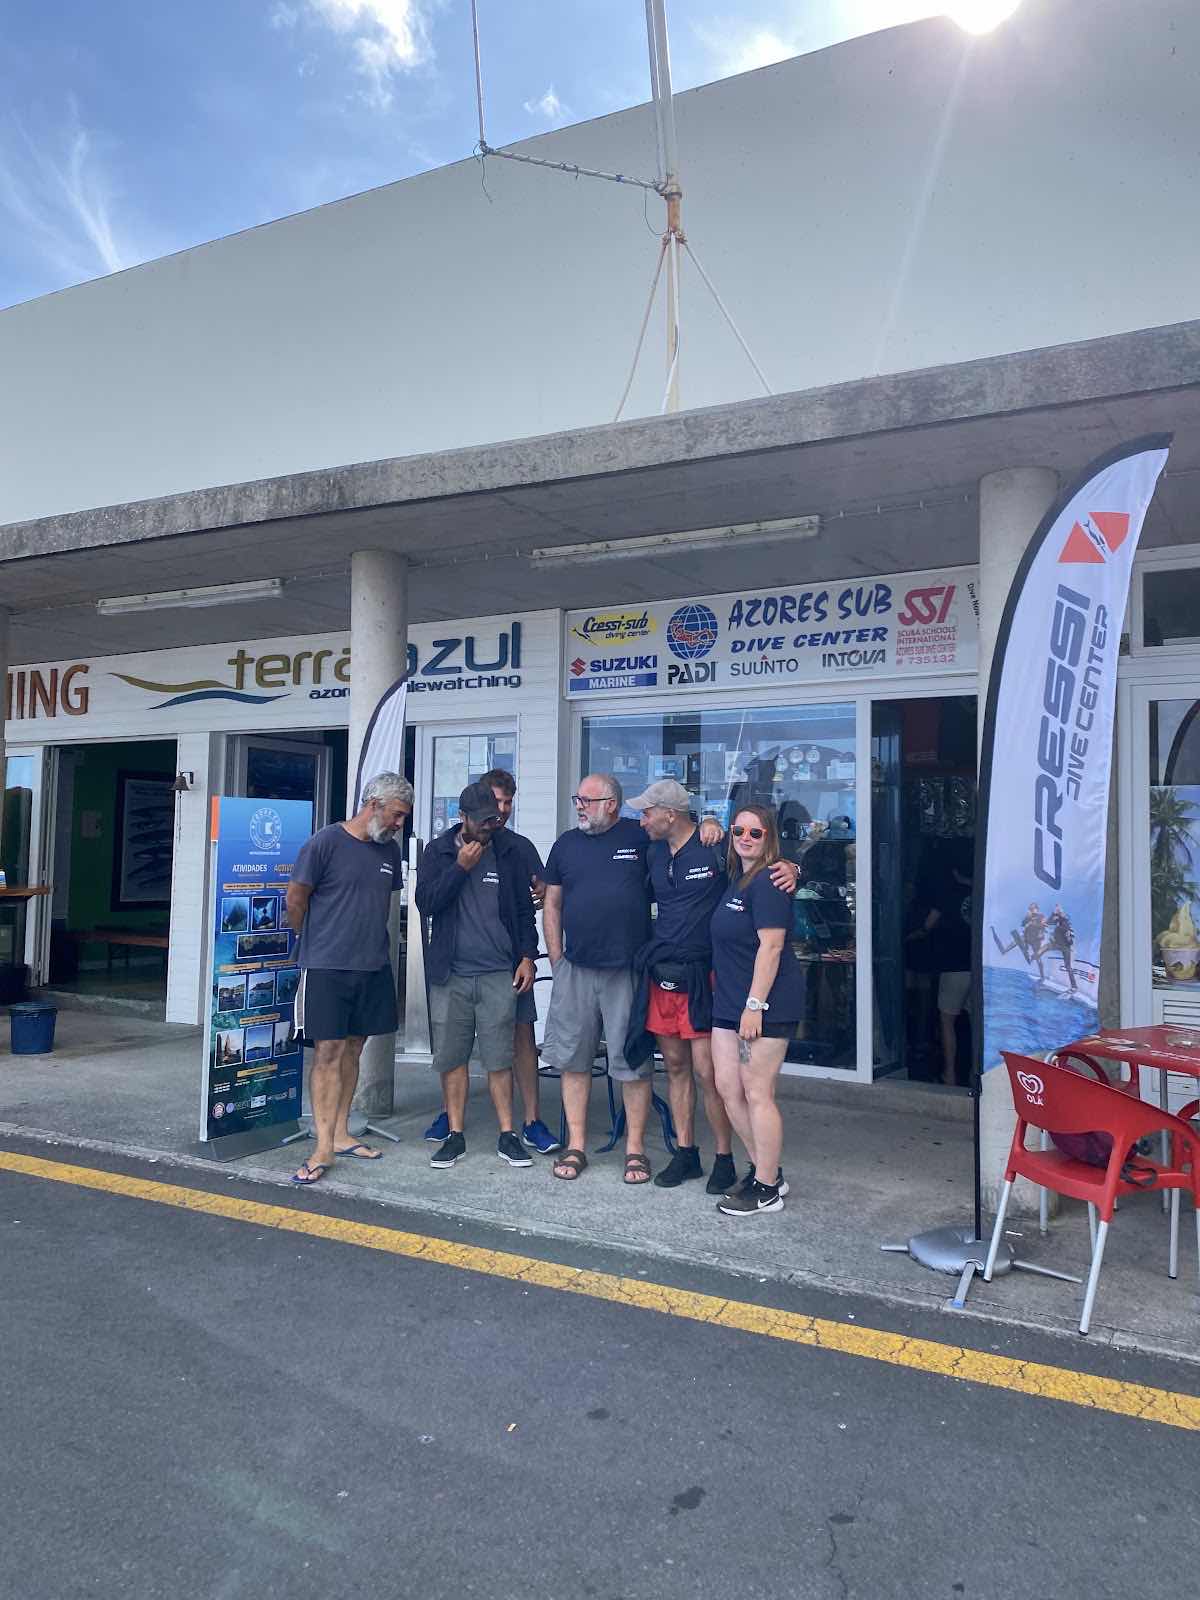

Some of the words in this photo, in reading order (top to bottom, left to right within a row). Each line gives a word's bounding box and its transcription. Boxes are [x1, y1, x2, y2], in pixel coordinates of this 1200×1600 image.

[728, 590, 829, 631] AZORES
[838, 583, 893, 620] SUB
[897, 584, 956, 626] SSI
[730, 636, 786, 654] DIVE
[793, 626, 889, 649] CENTER
[590, 654, 658, 673] SUZUKI
[730, 658, 799, 677] SUUNTO
[822, 649, 886, 668] INTOVA
[1076, 604, 1108, 732] CENTER
[589, 676, 636, 689] MARINE
[667, 661, 716, 685] PADI
[1034, 584, 1091, 890] CRESSI
[1067, 732, 1088, 801] DIVE
